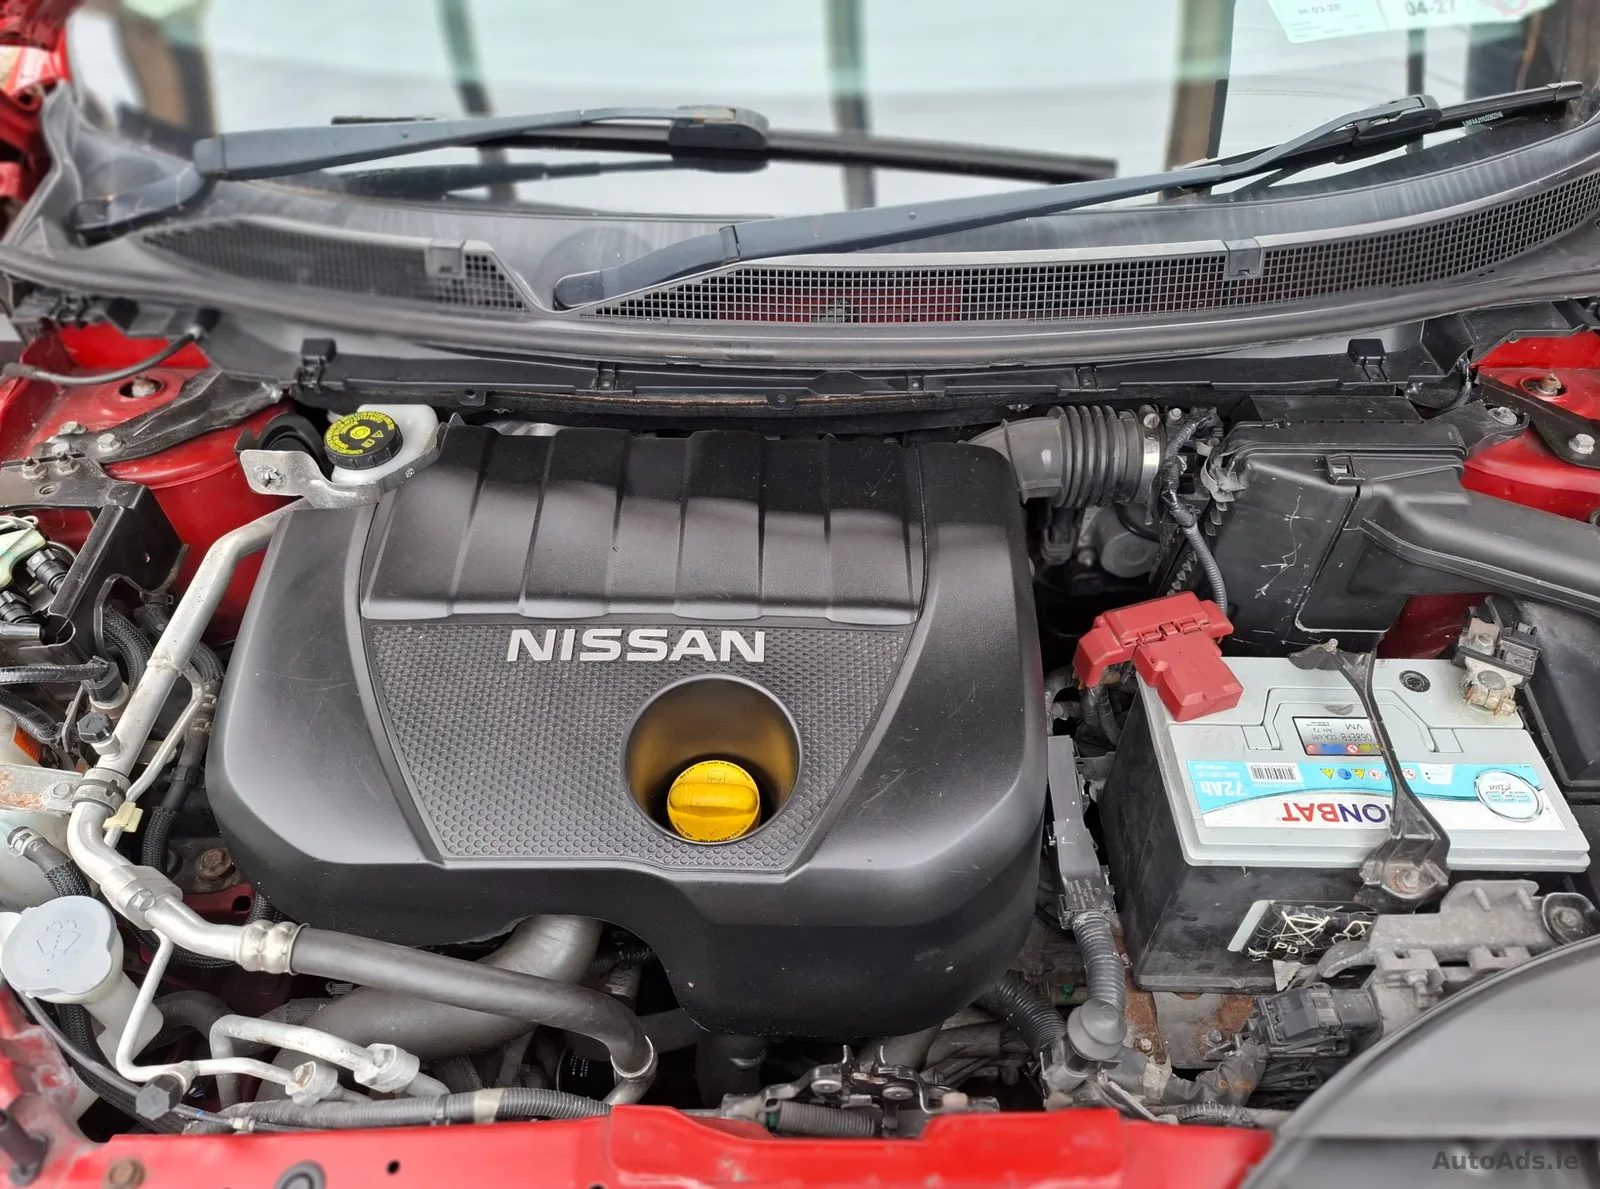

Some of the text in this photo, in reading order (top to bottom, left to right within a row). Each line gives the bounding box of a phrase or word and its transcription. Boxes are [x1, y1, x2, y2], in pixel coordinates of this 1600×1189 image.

[507, 628, 765, 662] NISSAN
[1200, 780, 1248, 796] 72Ah
[1274, 942, 1299, 954] Pb
